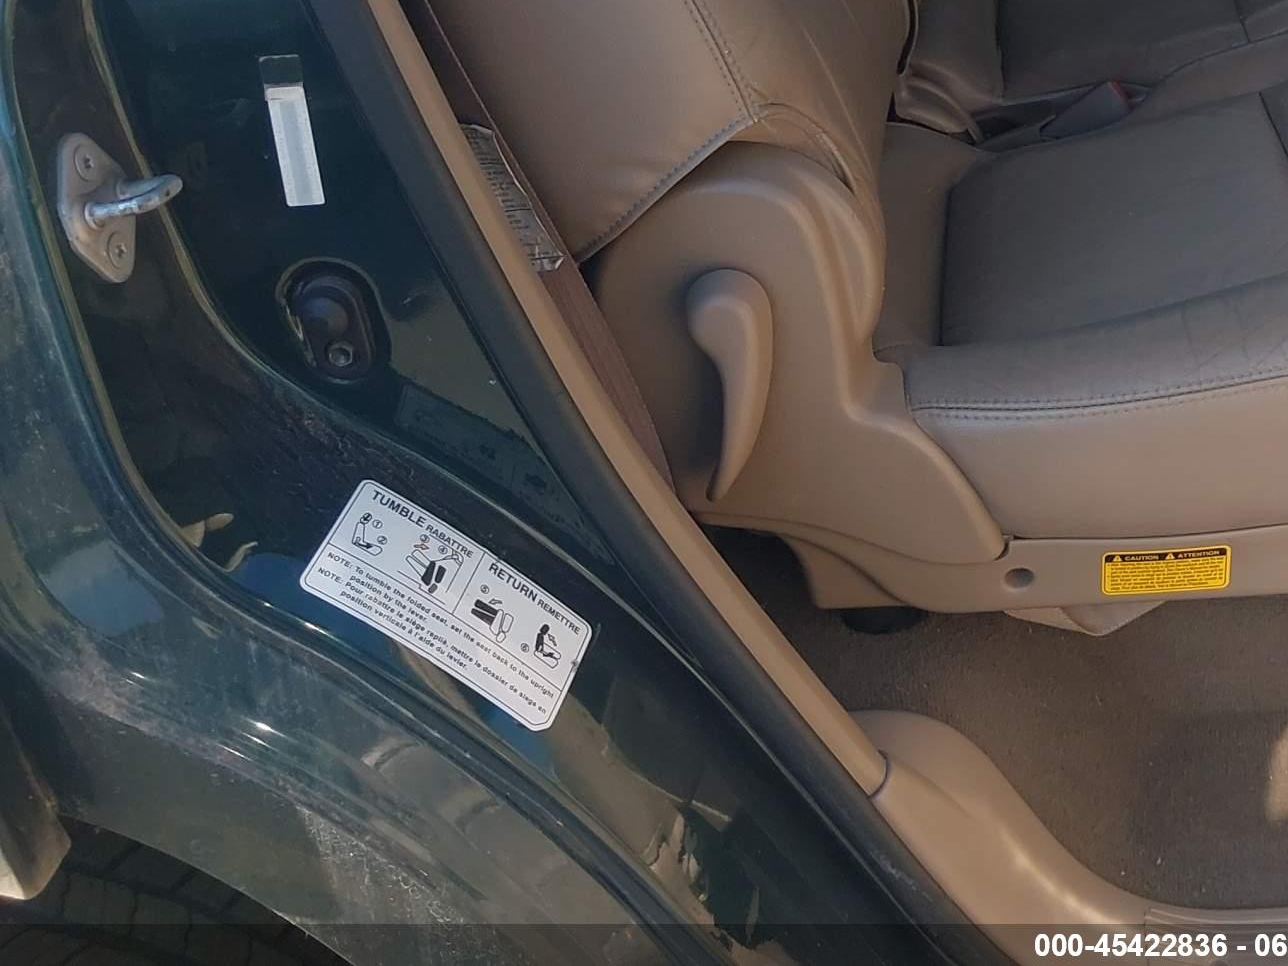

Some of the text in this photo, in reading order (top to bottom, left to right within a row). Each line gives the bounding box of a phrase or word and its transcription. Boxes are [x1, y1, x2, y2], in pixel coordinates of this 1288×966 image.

[372, 489, 474, 559] TUMBLE RABATTRE
[1177, 549, 1220, 558] ATTENTION
[318, 567, 344, 584] NOTE:
[345, 581, 364, 595] Pour
[349, 575, 382, 595] position
[383, 593, 394, 603] by
[395, 599, 407, 610] the
[488, 562, 581, 635] RETURN REMETTRE
[327, 552, 352, 569] NOTE:
[355, 565, 364, 575] To
[366, 572, 392, 591] tumble
[393, 588, 405, 599] the
[407, 596, 431, 614] folded
[463, 632, 475, 642] the
[510, 663, 517, 672] to
[518, 669, 529, 680] the
[530, 679, 554, 698] upright
[340, 590, 373, 611] position
[436, 646, 446, 655] du
